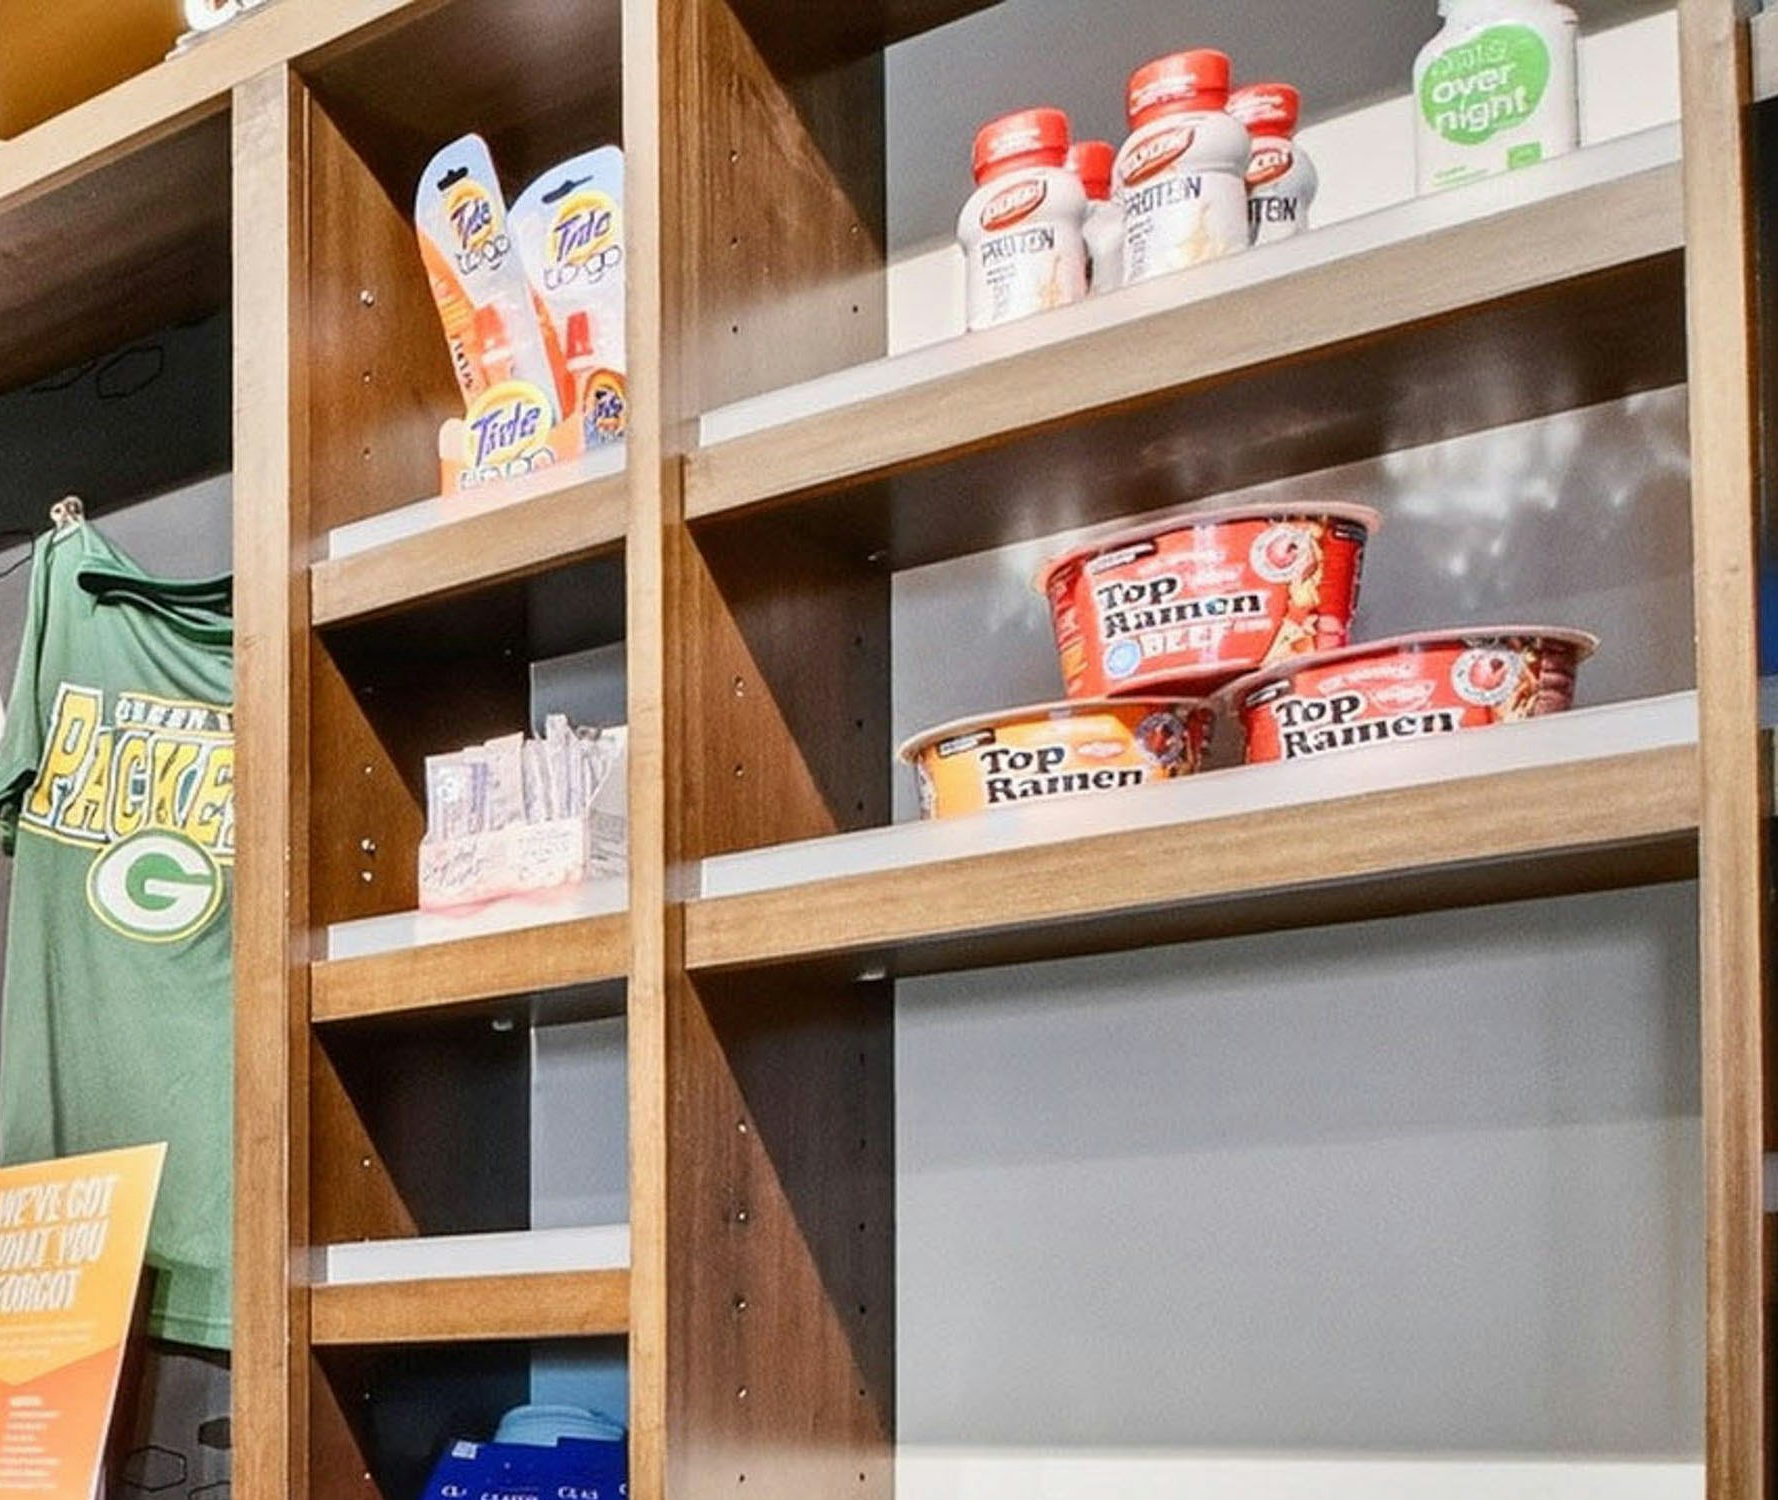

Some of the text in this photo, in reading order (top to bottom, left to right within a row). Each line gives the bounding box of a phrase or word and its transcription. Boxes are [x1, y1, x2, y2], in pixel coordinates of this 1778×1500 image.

[1432, 64, 1516, 103] over
[1436, 85, 1528, 133] night
[554, 212, 611, 261] Tide
[472, 403, 541, 466] Tide
[1098, 576, 1178, 608] Top
[1104, 594, 1262, 638] Ramen
[1277, 694, 1359, 726] Top
[1282, 711, 1454, 760] Ramen
[22, 682, 234, 850] PACKE
[981, 744, 1065, 774] Top
[985, 770, 1143, 804] Ramen
[95, 834, 213, 931] G
[68, 1174, 119, 1219] GOT
[57, 1219, 110, 1263] YOU
